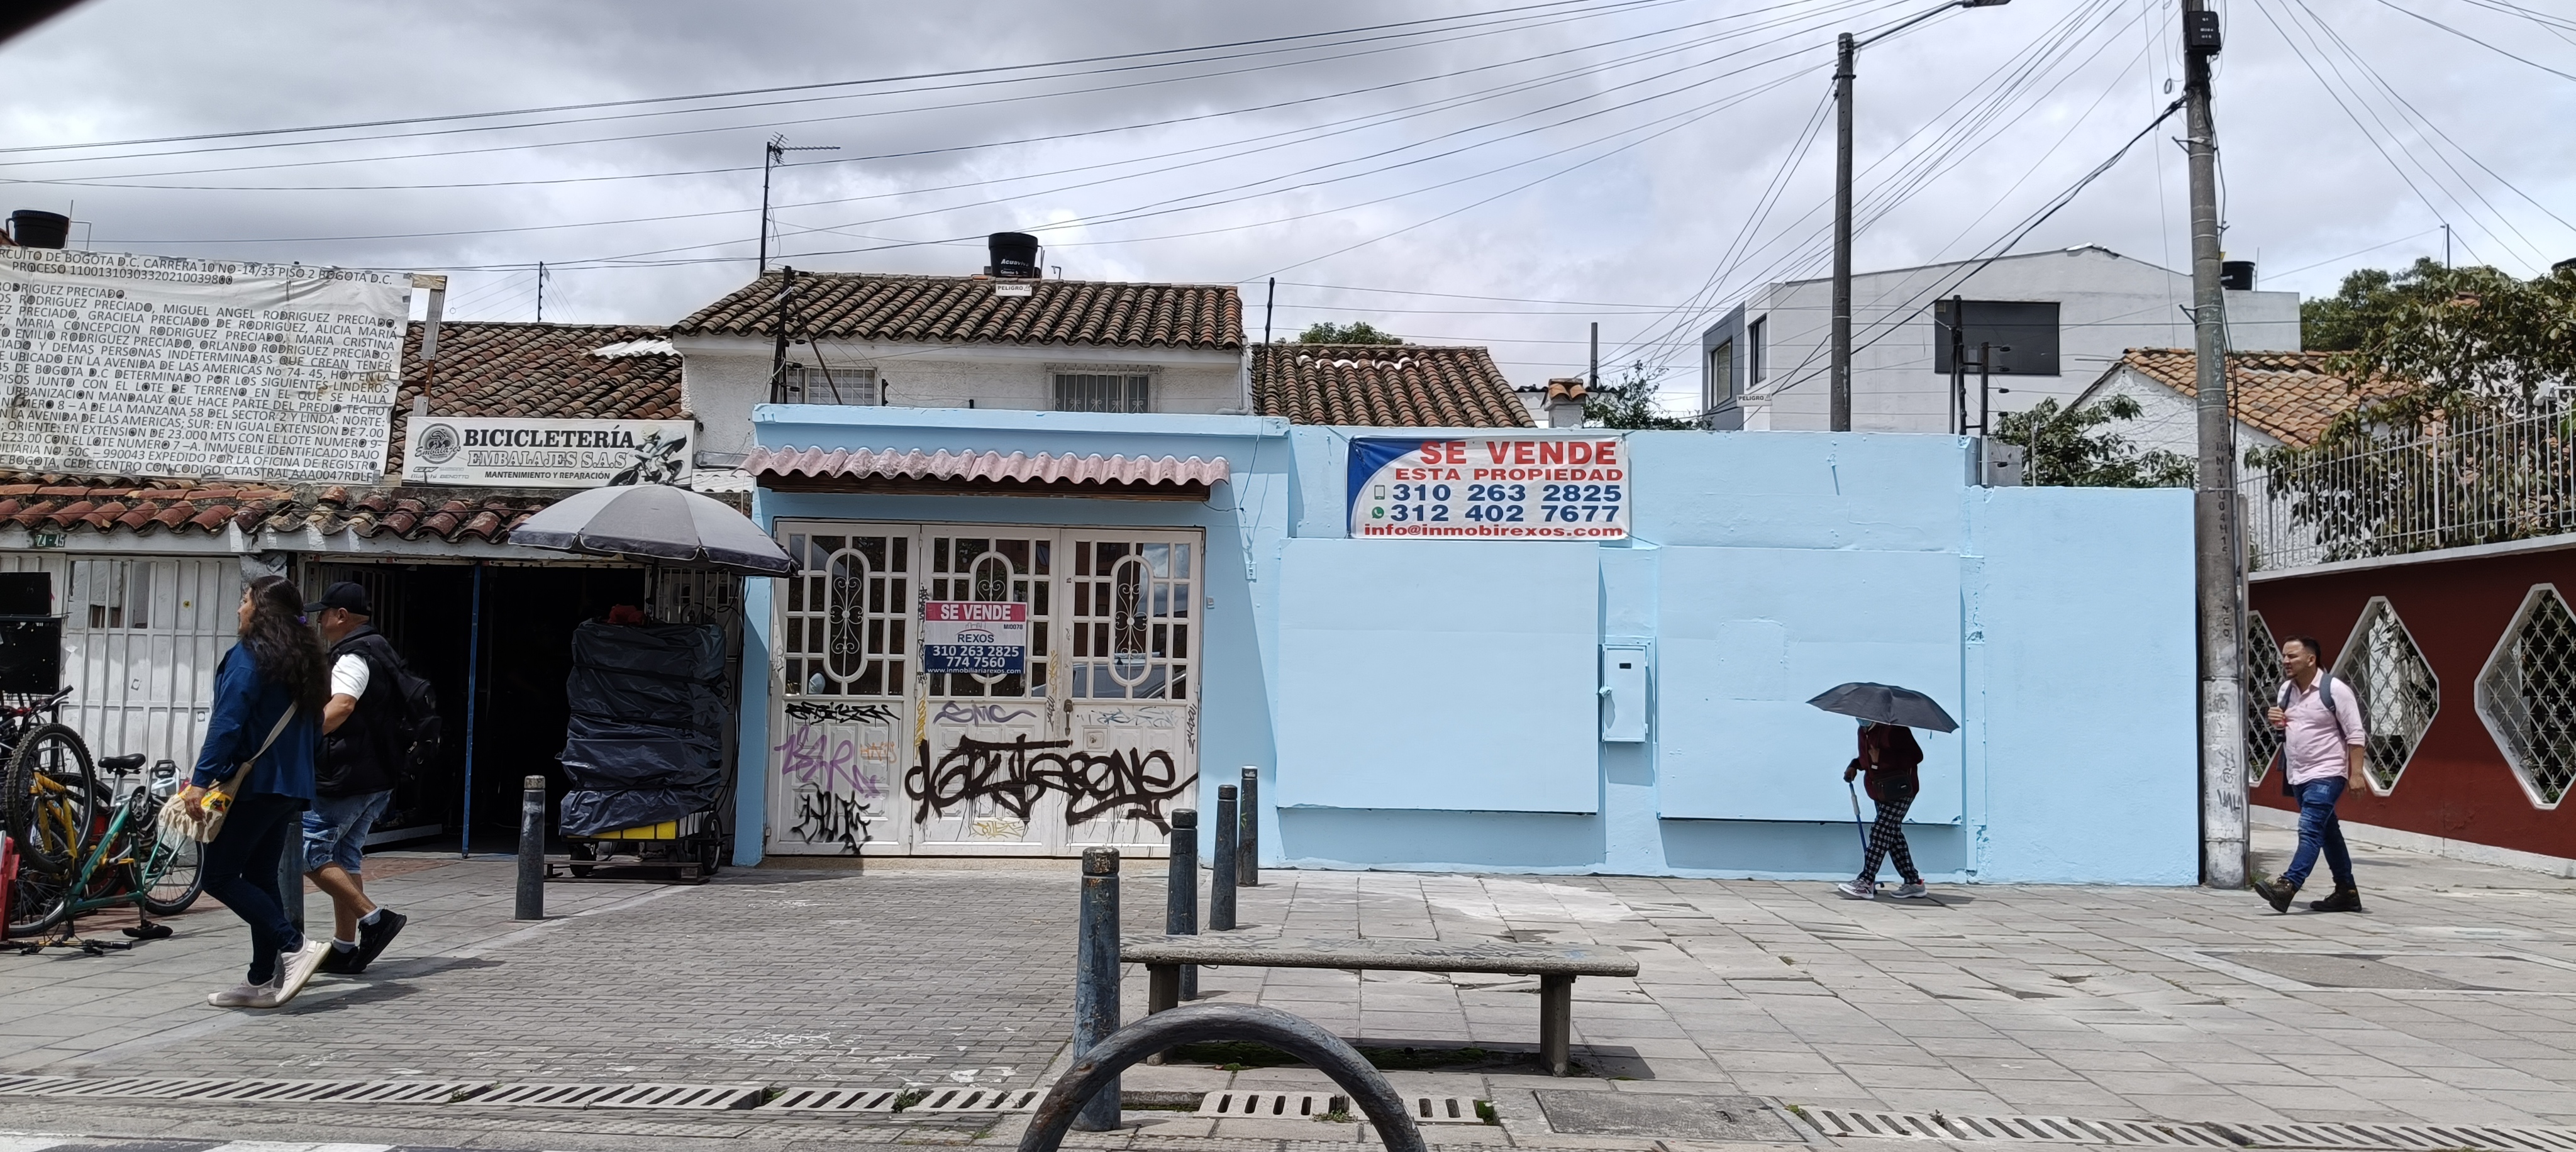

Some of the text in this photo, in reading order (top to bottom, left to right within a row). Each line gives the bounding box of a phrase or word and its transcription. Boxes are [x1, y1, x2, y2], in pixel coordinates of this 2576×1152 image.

[12, 261, 66, 274] PROCESO
[45, 252, 62, 262] DE
[65, 253, 114, 265] BOGOTA
[118, 257, 140, 267] D.C.
[143, 258, 197, 271] CARRERA
[201, 262, 214, 272] 10
[218, 263, 236, 274] NO
[279, 267, 304, 278] PISO
[318, 270, 367, 282] BOGOTA
[370, 273, 393, 284] D.C.
[66, 286, 128, 299] PRECIADO.
[19, 294, 398, 329] RODRIGUEZ PRECIADO, MIGUEL ANGEL RODRIGUEZ PRECIADO,
[19, 306, 397, 339] PRECIADO, GRACIELA PRECIADO DE RODRIGUEZ, ALICIA MARIA
[15, 317, 395, 350] MARIA CONCEPCION RODRIGUEZ PRECIADO, MARIA CRISTINA
[15, 328, 394, 362] EMILIO RODRIGUEZ PRECIADO, ORLANDO RODRIGUEZ PRECIADO,
[52, 342, 94, 354] DEMAS
[101, 345, 161, 358] PERSONAS
[168, 349, 274, 365] INDETERMINADAS
[279, 355, 304, 368] QUE
[310, 357, 350, 370] CREAN
[355, 360, 392, 371] TENER
[14, 363, 30, 374] DE
[35, 364, 83, 376] BOGOTA
[114, 369, 201, 383] DETERMINADO
[206, 374, 230, 384] POR
[235, 375, 257, 386] LOS
[260, 377, 328, 390] SIGUIENTES
[333, 381, 390, 394] LINDEROS
[36, 376, 74, 387] JUNTO
[82, 379, 108, 389] CON
[115, 380, 128, 390] EL
[135, 381, 163, 392] LOTE
[171, 384, 186, 394] DE
[193, 384, 247, 397] TERRENO
[254, 387, 270, 397] EN
[277, 389, 291, 399] EL
[297, 390, 323, 402] QUE
[330, 392, 343, 402] SE
[350, 393, 386, 404] HALLA
[6, 385, 385, 416] URBANIZACION MANDALAY QUE HACE PARTE DEL PREDIO TECHO
[7, 420, 60, 433] ORIENTE:
[64, 423, 78, 433] EN
[82, 424, 146, 437] EXTENSION
[149, 428, 165, 438] DE
[167, 429, 208, 440] 23.000
[210, 431, 235, 441] MTS
[238, 432, 264, 443] CON
[267, 433, 281, 444] EL
[282, 435, 311, 445] LOTE
[314, 436, 367, 448] NUMERO
[9, 431, 42, 443] 23.00
[44, 434, 69, 445] CON
[72, 435, 84, 445] EL
[86, 436, 114, 447] LOTE
[117, 438, 170, 450] NUMERO
[204, 442, 265, 455] INMUEBLE
[267, 445, 348, 458] IDENTIFICADO
[349, 449, 380, 460] BAJO
[463, 424, 635, 448] BICICLETERÍA
[67, 446, 91, 457] 50C
[102, 448, 145, 460] 990043
[148, 450, 206, 463] EXPEDIDO
[209, 453, 233, 463] POR
[236, 455, 250, 465] LA
[253, 455, 300, 467] OFICINA
[303, 458, 321, 468] DE
[321, 458, 378, 470] REGISTRO
[467, 450, 629, 469] EMBALAJES S.A.S
[1420, 441, 1617, 465] SE VENDE
[63, 457, 94, 468] CEDE
[96, 459, 142, 471] CENTRO
[145, 462, 170, 472] CON
[174, 463, 221, 475] CODIGO
[224, 465, 288, 478] CATASTRAL
[485, 471, 551, 479] MANTENIMIENTO
[559, 471, 611, 480] REPARACIÓN
[1395, 468, 1623, 481] ESTA PROPIEDAD
[1392, 484, 1622, 502] 310 263 2825
[1390, 505, 1619, 523] 312 402 7677
[1365, 524, 1623, 537] info@inmobirexos.com
[941, 604, 1011, 621] SE VENDE
[957, 634, 994, 643] REXOS
[933, 646, 1019, 657] 310 263 2825
[946, 656, 1006, 668] 774 7560
